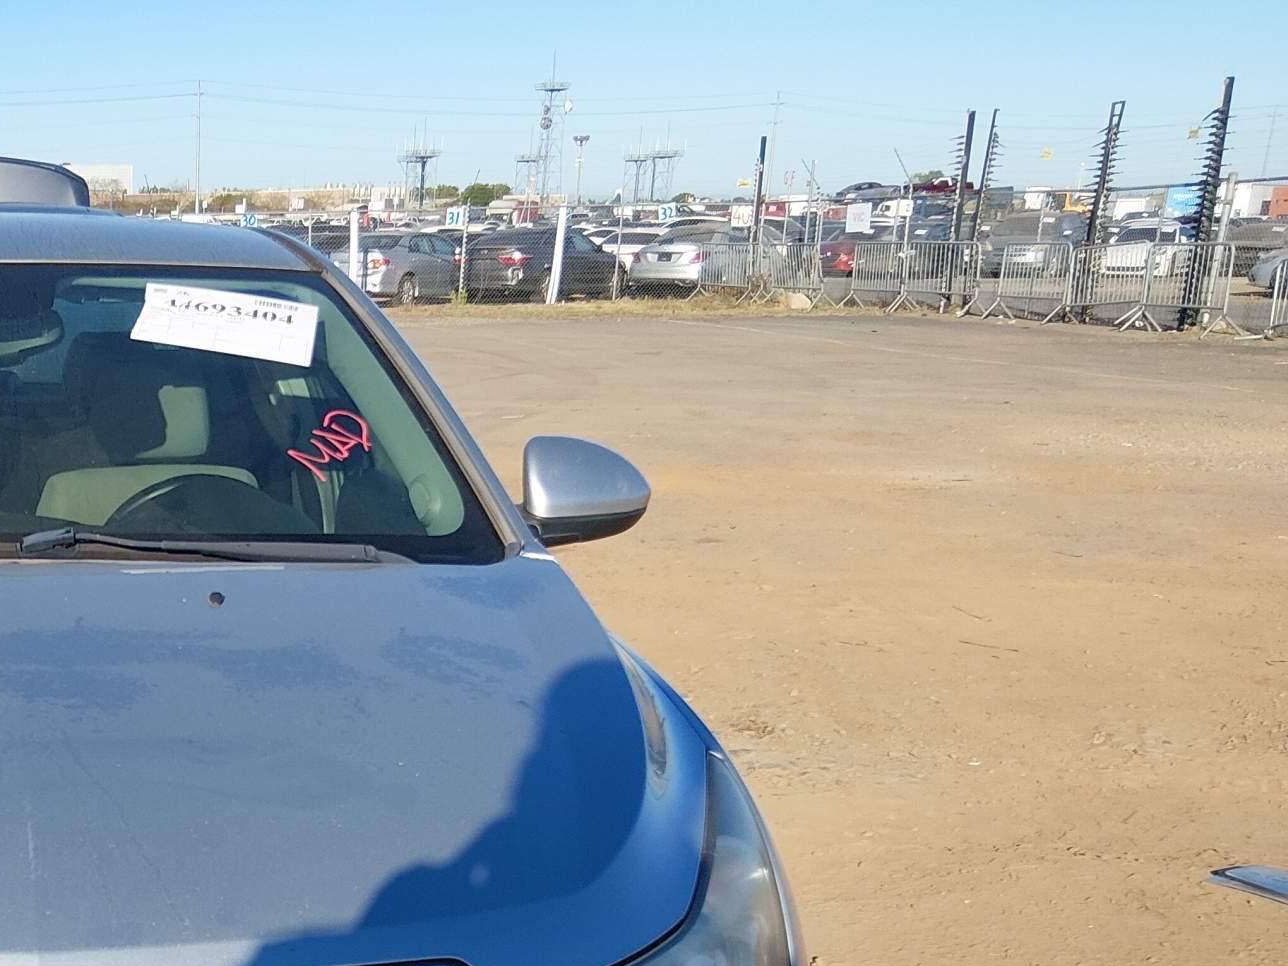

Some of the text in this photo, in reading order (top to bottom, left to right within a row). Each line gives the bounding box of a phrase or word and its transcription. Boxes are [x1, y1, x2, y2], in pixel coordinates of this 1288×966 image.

[242, 213, 257, 227] 30
[447, 211, 461, 226] 31
[660, 205, 674, 221] 32
